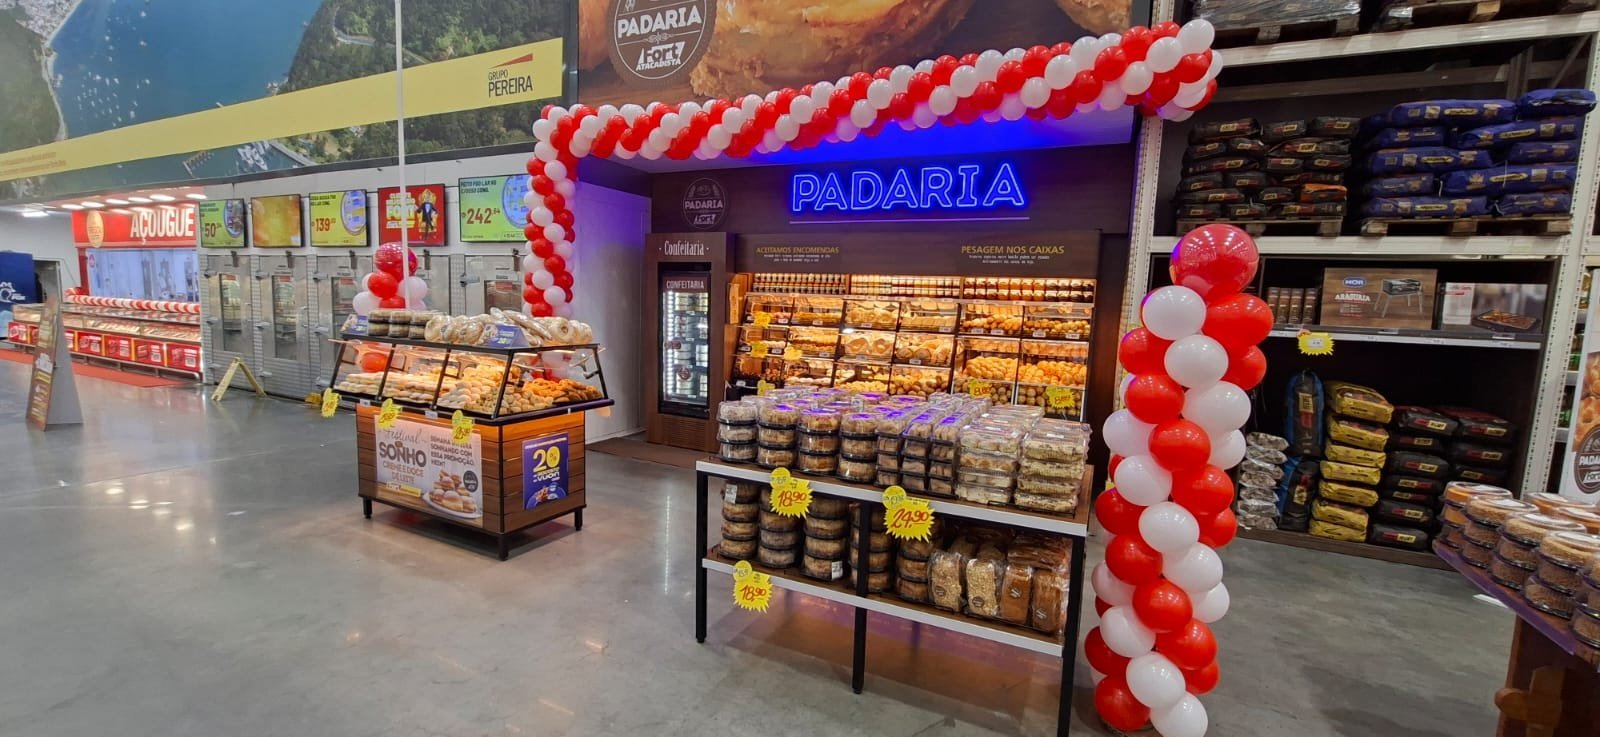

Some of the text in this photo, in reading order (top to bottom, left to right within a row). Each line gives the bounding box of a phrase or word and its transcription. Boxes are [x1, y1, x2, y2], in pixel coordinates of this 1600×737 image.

[617, 5, 702, 39] PADARIA
[636, 58, 681, 71] ATACADISTA
[488, 69, 508, 81] GRUPO
[488, 75, 533, 98] PEREIRA
[792, 163, 1025, 212] PADARIA
[684, 199, 723, 210] PADARIA
[130, 208, 194, 245] AÇOUGUE
[664, 240, 704, 256] Confeitaria
[756, 246, 840, 254] ACEITAMOS ENCOMENDAS
[961, 245, 1065, 254] PESAGEM NOS CAIXAS
[666, 280, 704, 290] CONFEITARIA
[378, 441, 427, 467] SONHO
